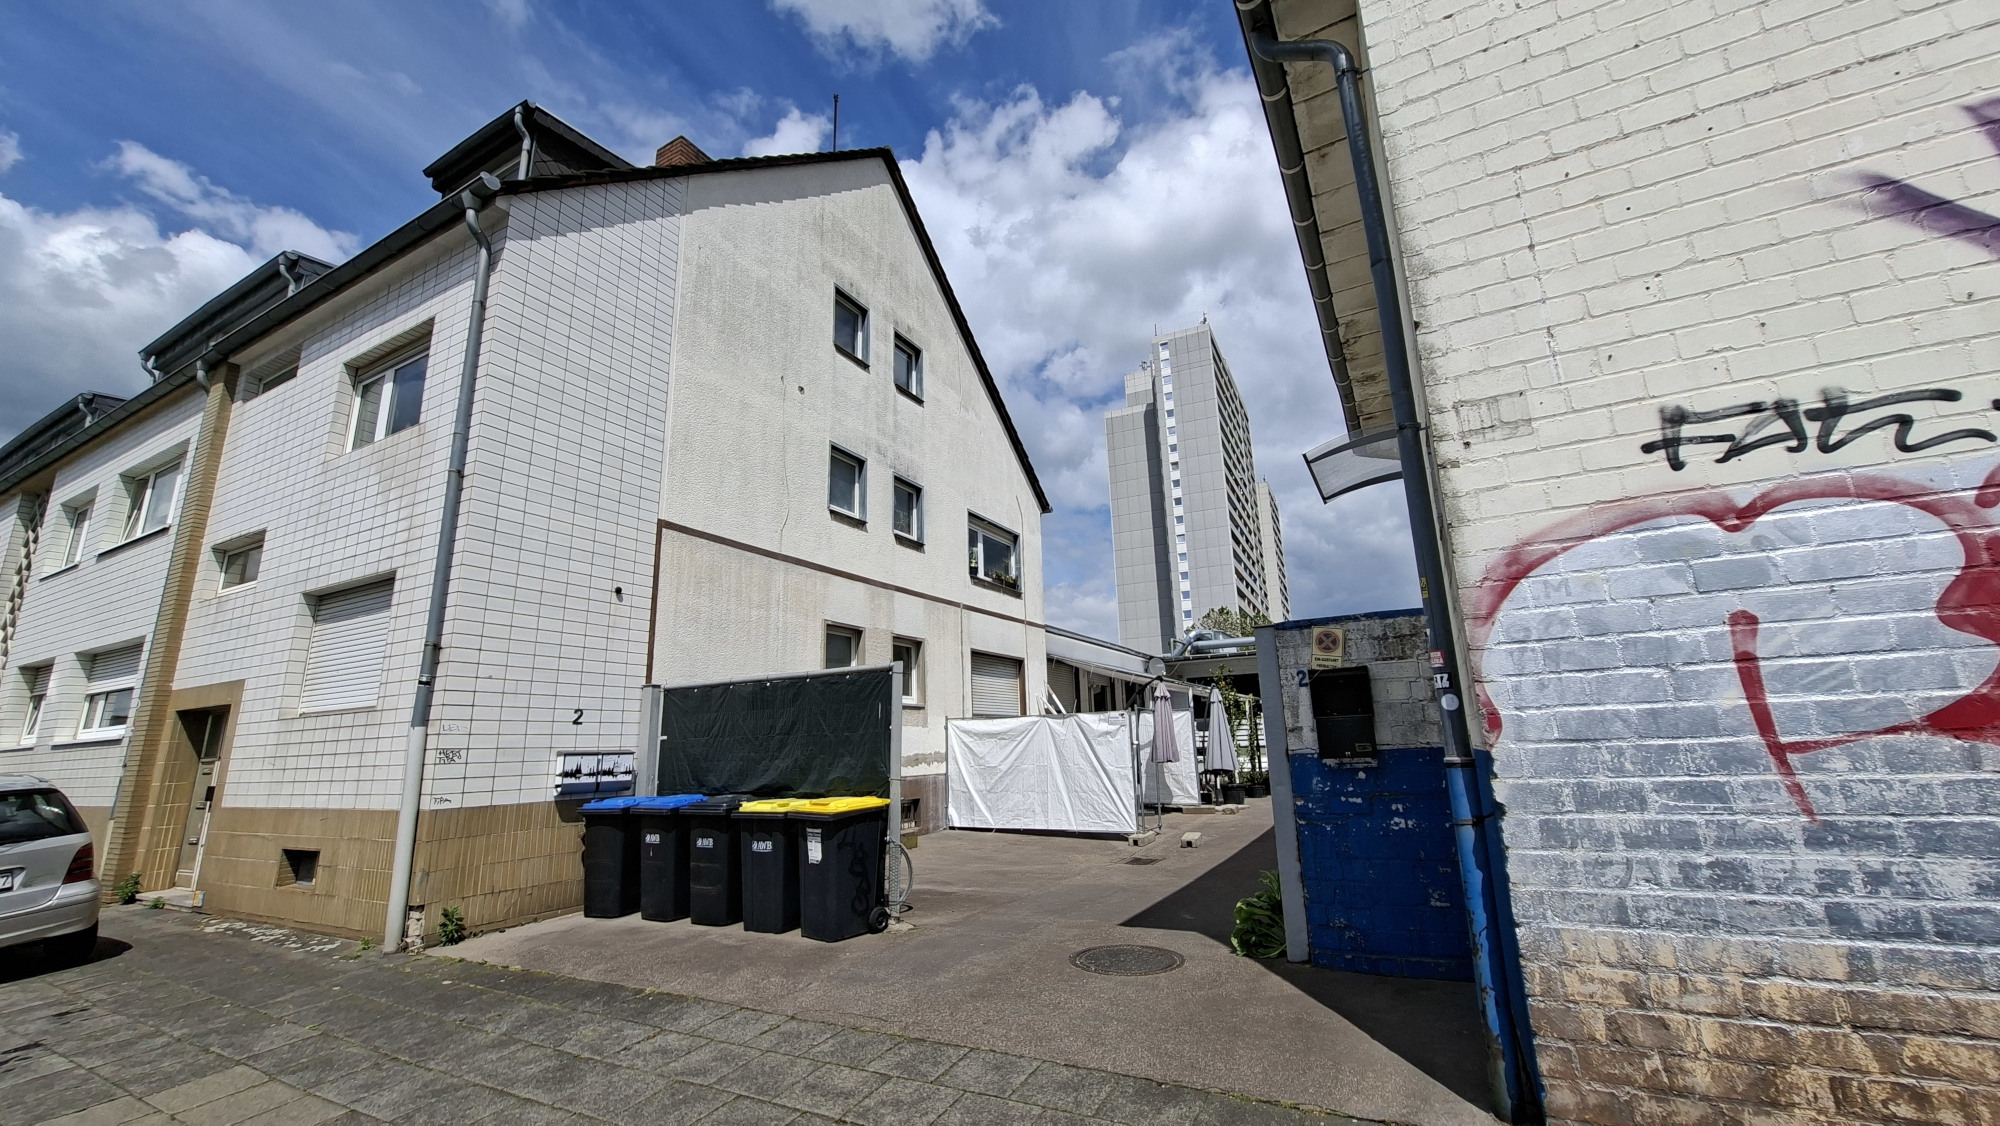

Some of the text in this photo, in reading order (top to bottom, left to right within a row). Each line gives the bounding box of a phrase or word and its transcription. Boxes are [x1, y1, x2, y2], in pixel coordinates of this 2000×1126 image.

[1296, 669, 1309, 688] 2
[572, 708, 584, 725] 2
[757, 840, 773, 850] AWB
